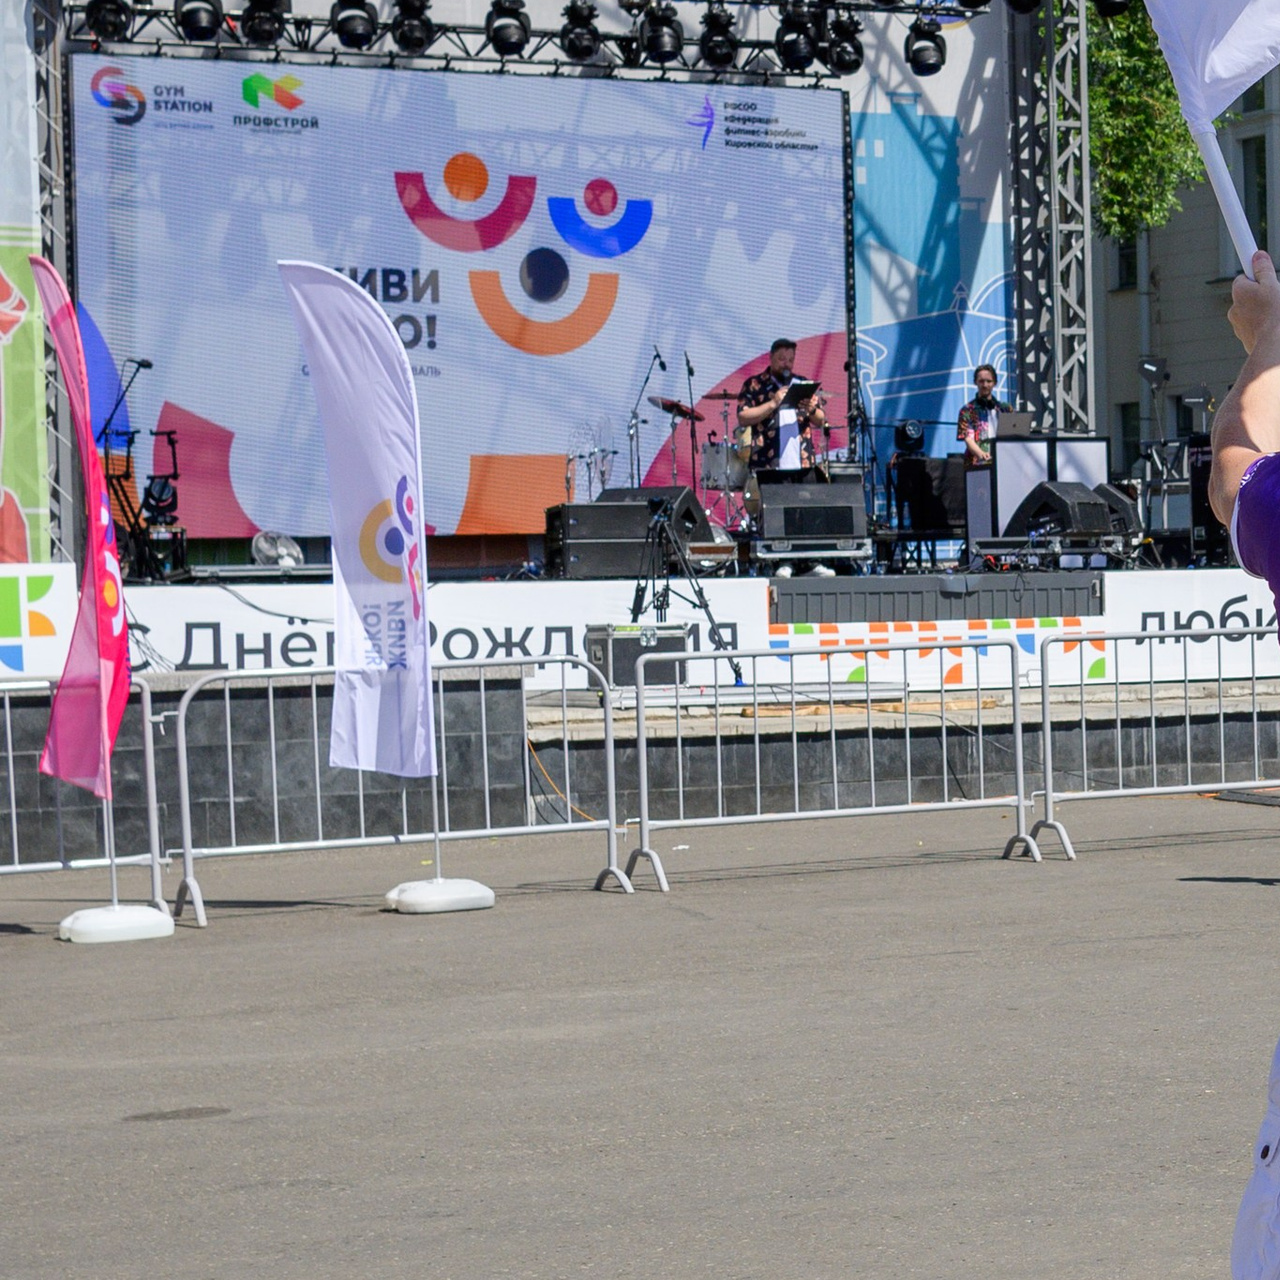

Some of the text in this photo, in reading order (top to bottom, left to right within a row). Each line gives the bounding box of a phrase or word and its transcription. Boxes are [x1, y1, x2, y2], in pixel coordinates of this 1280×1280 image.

[153, 85, 185, 97] GYM
[153, 99, 213, 113] STATION
[233, 114, 319, 129] ПРОФСТРОЙ
[334, 267, 440, 303] ИВИ
[175, 617, 336, 671] Днё
